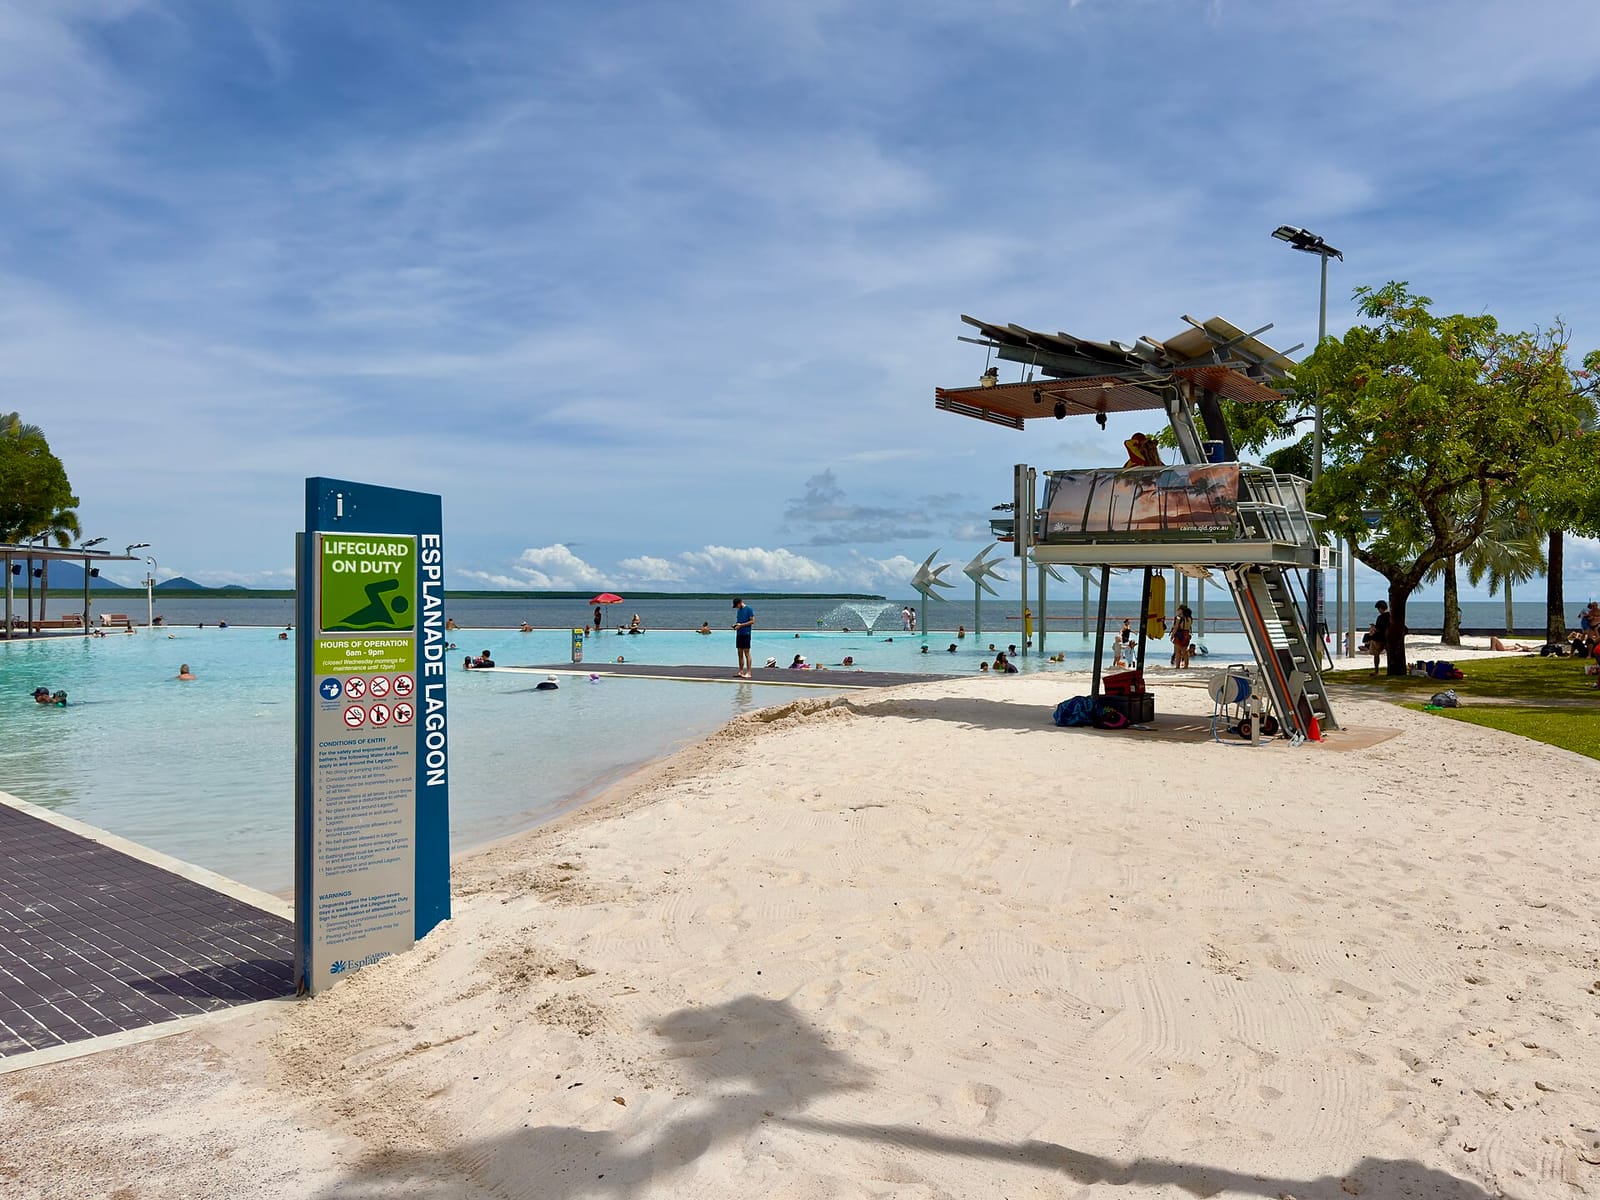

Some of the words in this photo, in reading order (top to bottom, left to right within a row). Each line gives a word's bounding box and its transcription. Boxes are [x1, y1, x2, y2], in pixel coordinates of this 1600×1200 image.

[325, 541, 408, 556] LIFEGUARD
[332, 560, 357, 573] ON
[360, 561, 402, 574] DUTY
[422, 534, 444, 677] ESPLANADE
[320, 641, 348, 649] HOURS
[368, 649, 384, 658] 9pm
[426, 684, 446, 786] LAGOON
[319, 891, 352, 900] WARNINGS
